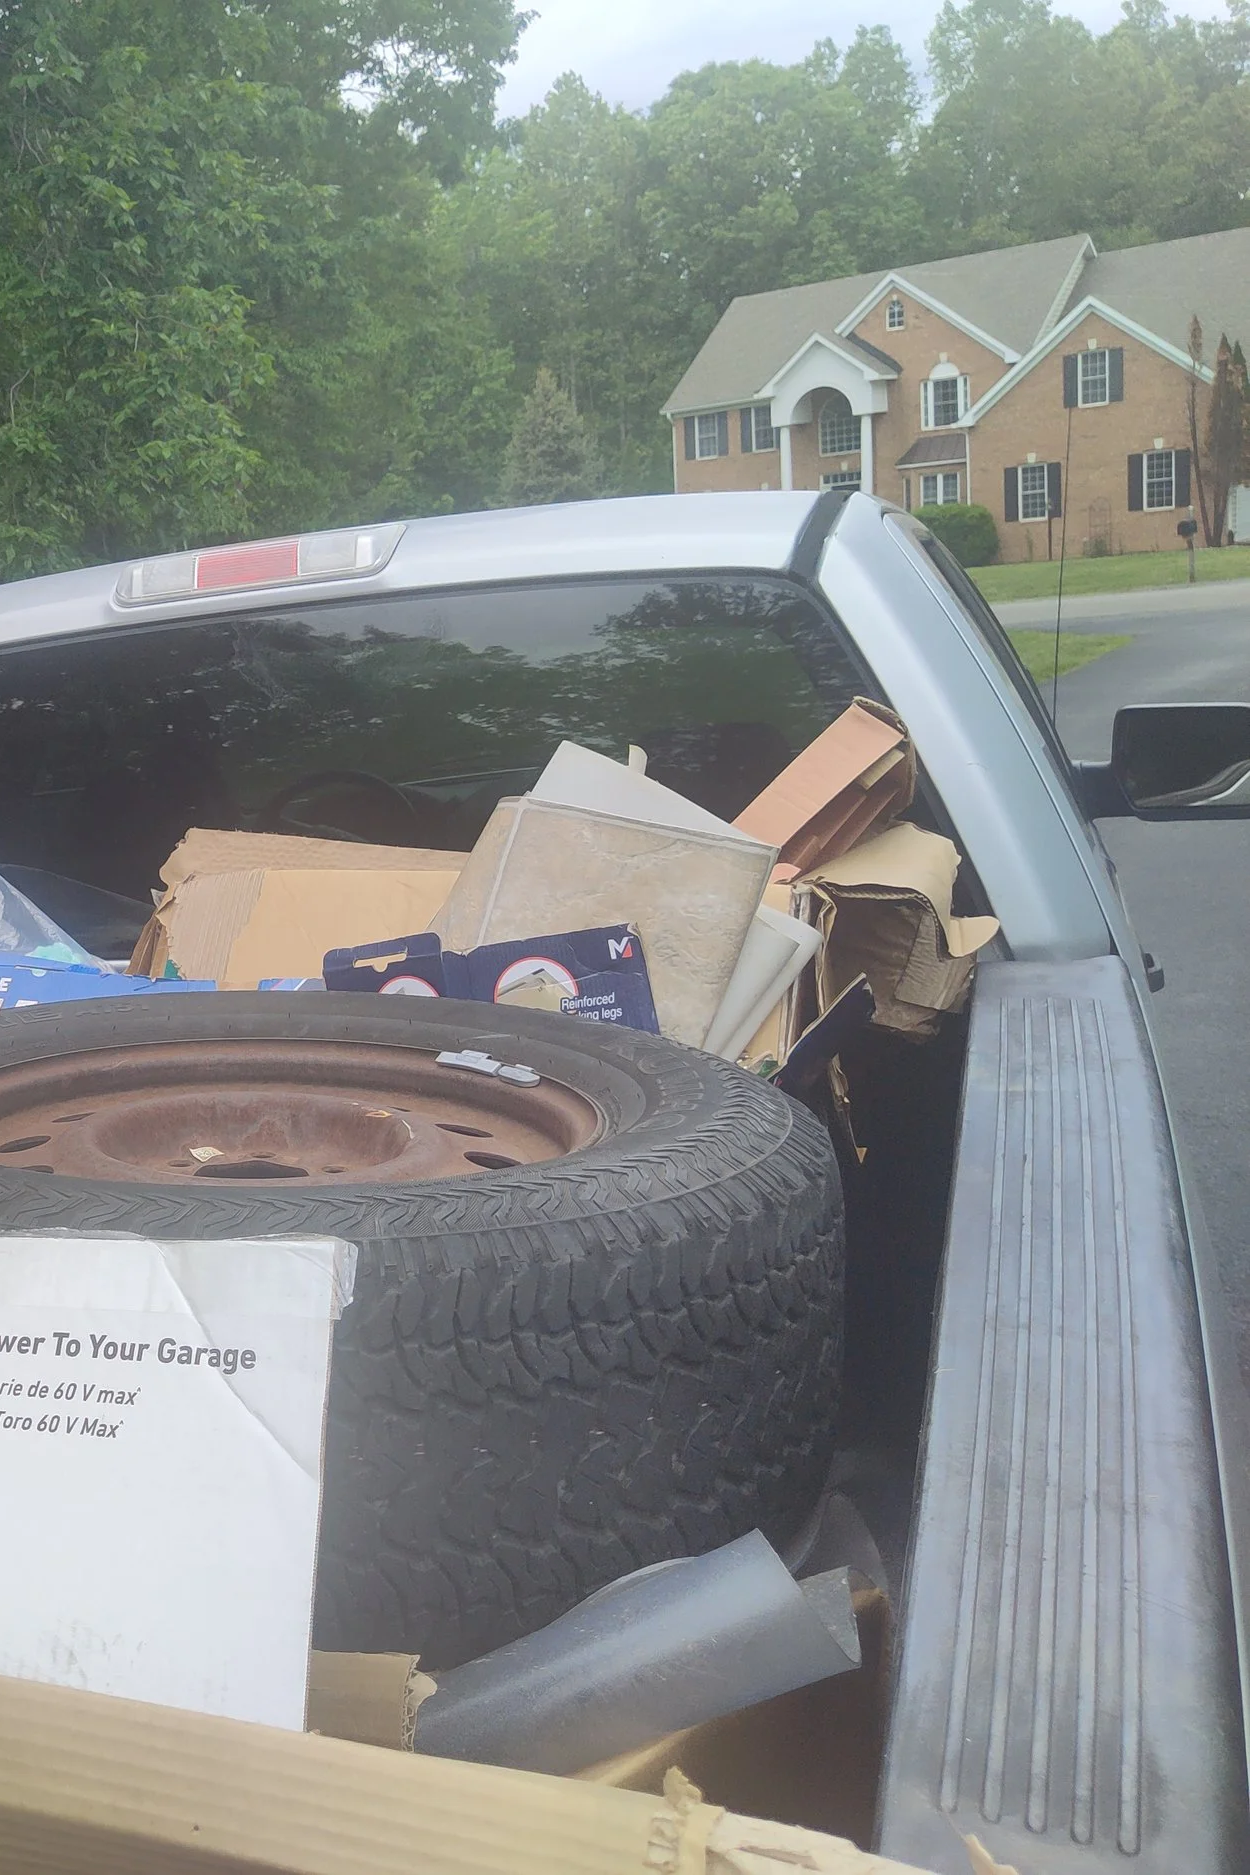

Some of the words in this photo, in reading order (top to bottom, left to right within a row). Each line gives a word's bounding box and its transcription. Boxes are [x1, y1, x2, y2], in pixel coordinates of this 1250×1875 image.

[561, 991, 615, 1011] Reinforced
[601, 1007, 623, 1020] legs
[52, 1332, 81, 1358] To
[89, 1334, 151, 1362] Your
[157, 1337, 257, 1375] Garage
[27, 1381, 49, 1399] de
[53, 1383, 77, 1401] 60
[82, 1385, 95, 1402] V
[36, 1415, 60, 1434] 60
[64, 1417, 77, 1435] V
